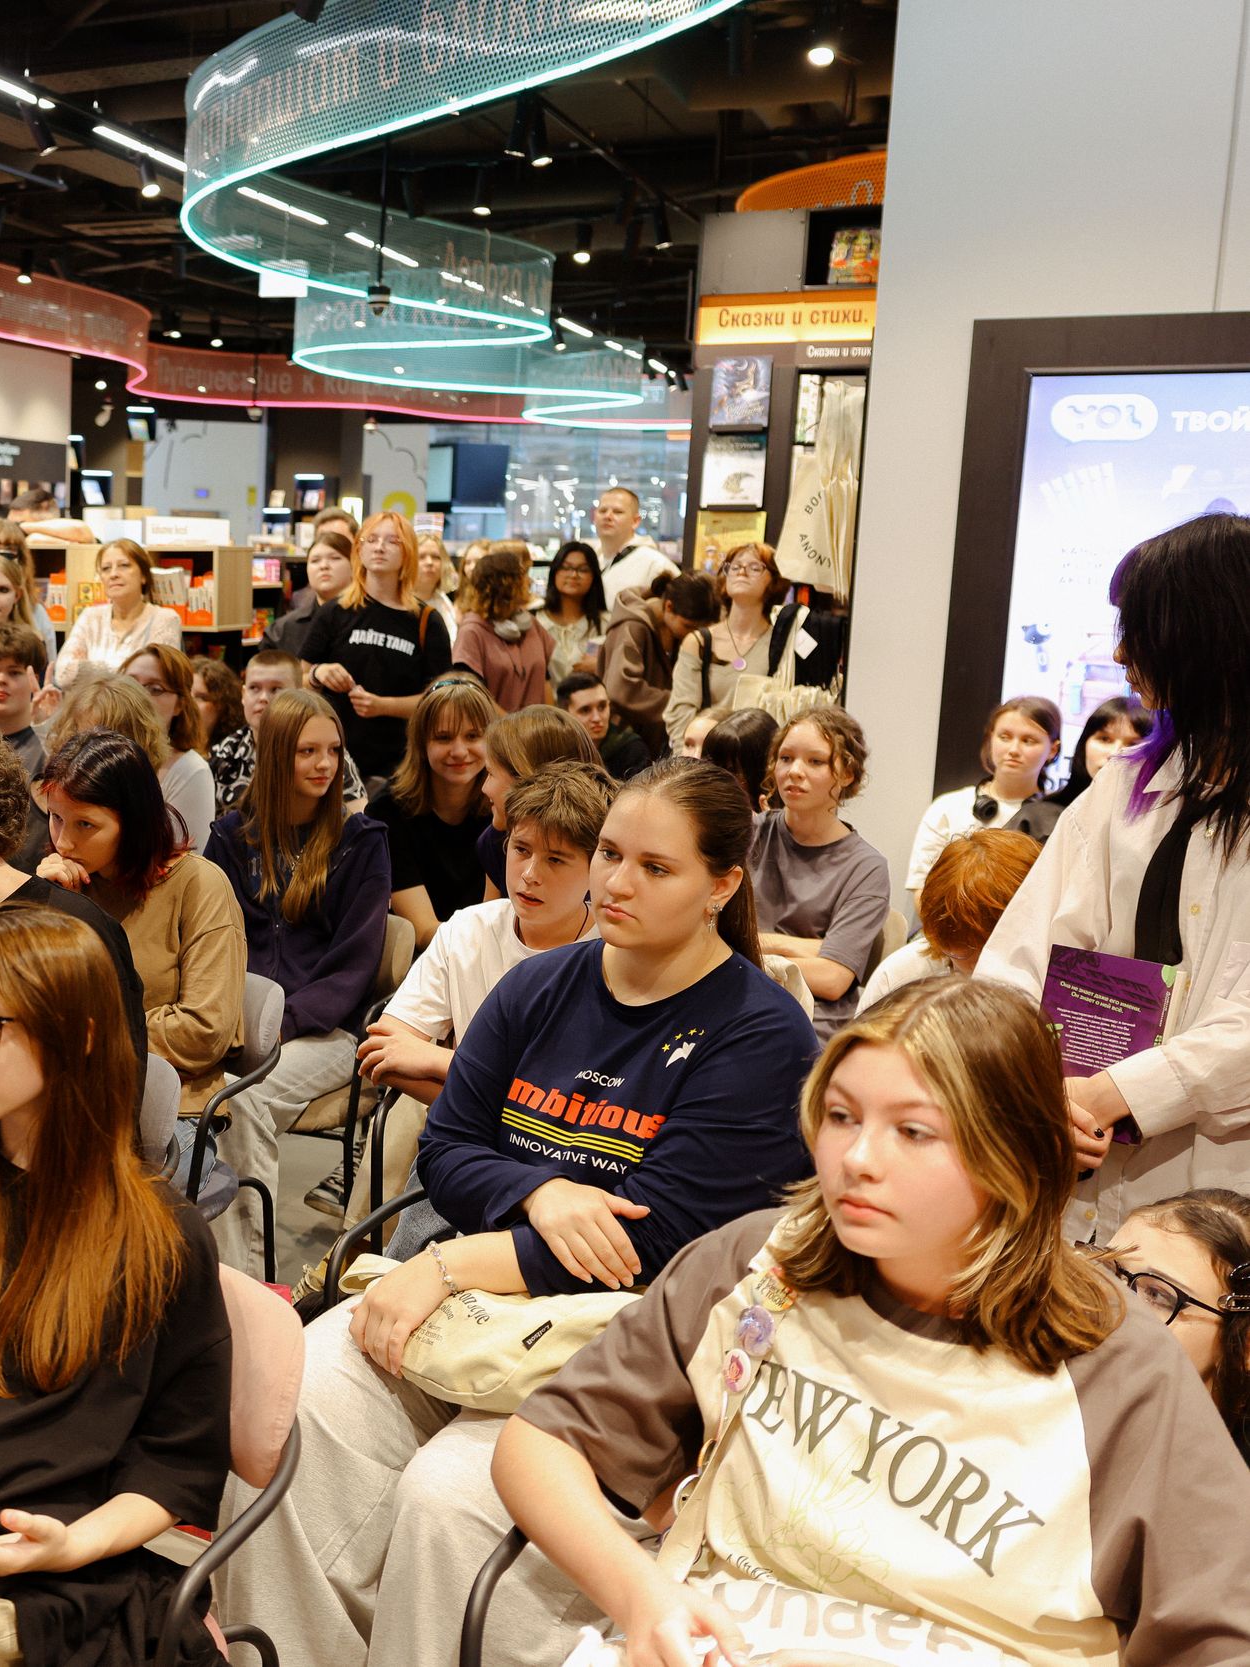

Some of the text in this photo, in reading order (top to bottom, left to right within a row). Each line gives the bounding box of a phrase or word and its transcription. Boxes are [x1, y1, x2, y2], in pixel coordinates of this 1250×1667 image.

[719, 308, 869, 328] Сказки и стихи.
[806, 345, 840, 359] Сказки
[842, 346, 850, 358] и
[1171, 405, 1250, 433] ТВОЙ
[348, 628, 386, 647] ДАЙТЕ
[575, 1070, 626, 1088] MOSCOW
[507, 1077, 667, 1140] mbitious
[509, 1132, 628, 1175] INNOVATIVE WAY
[744, 1359, 1046, 1578] EW YORK
